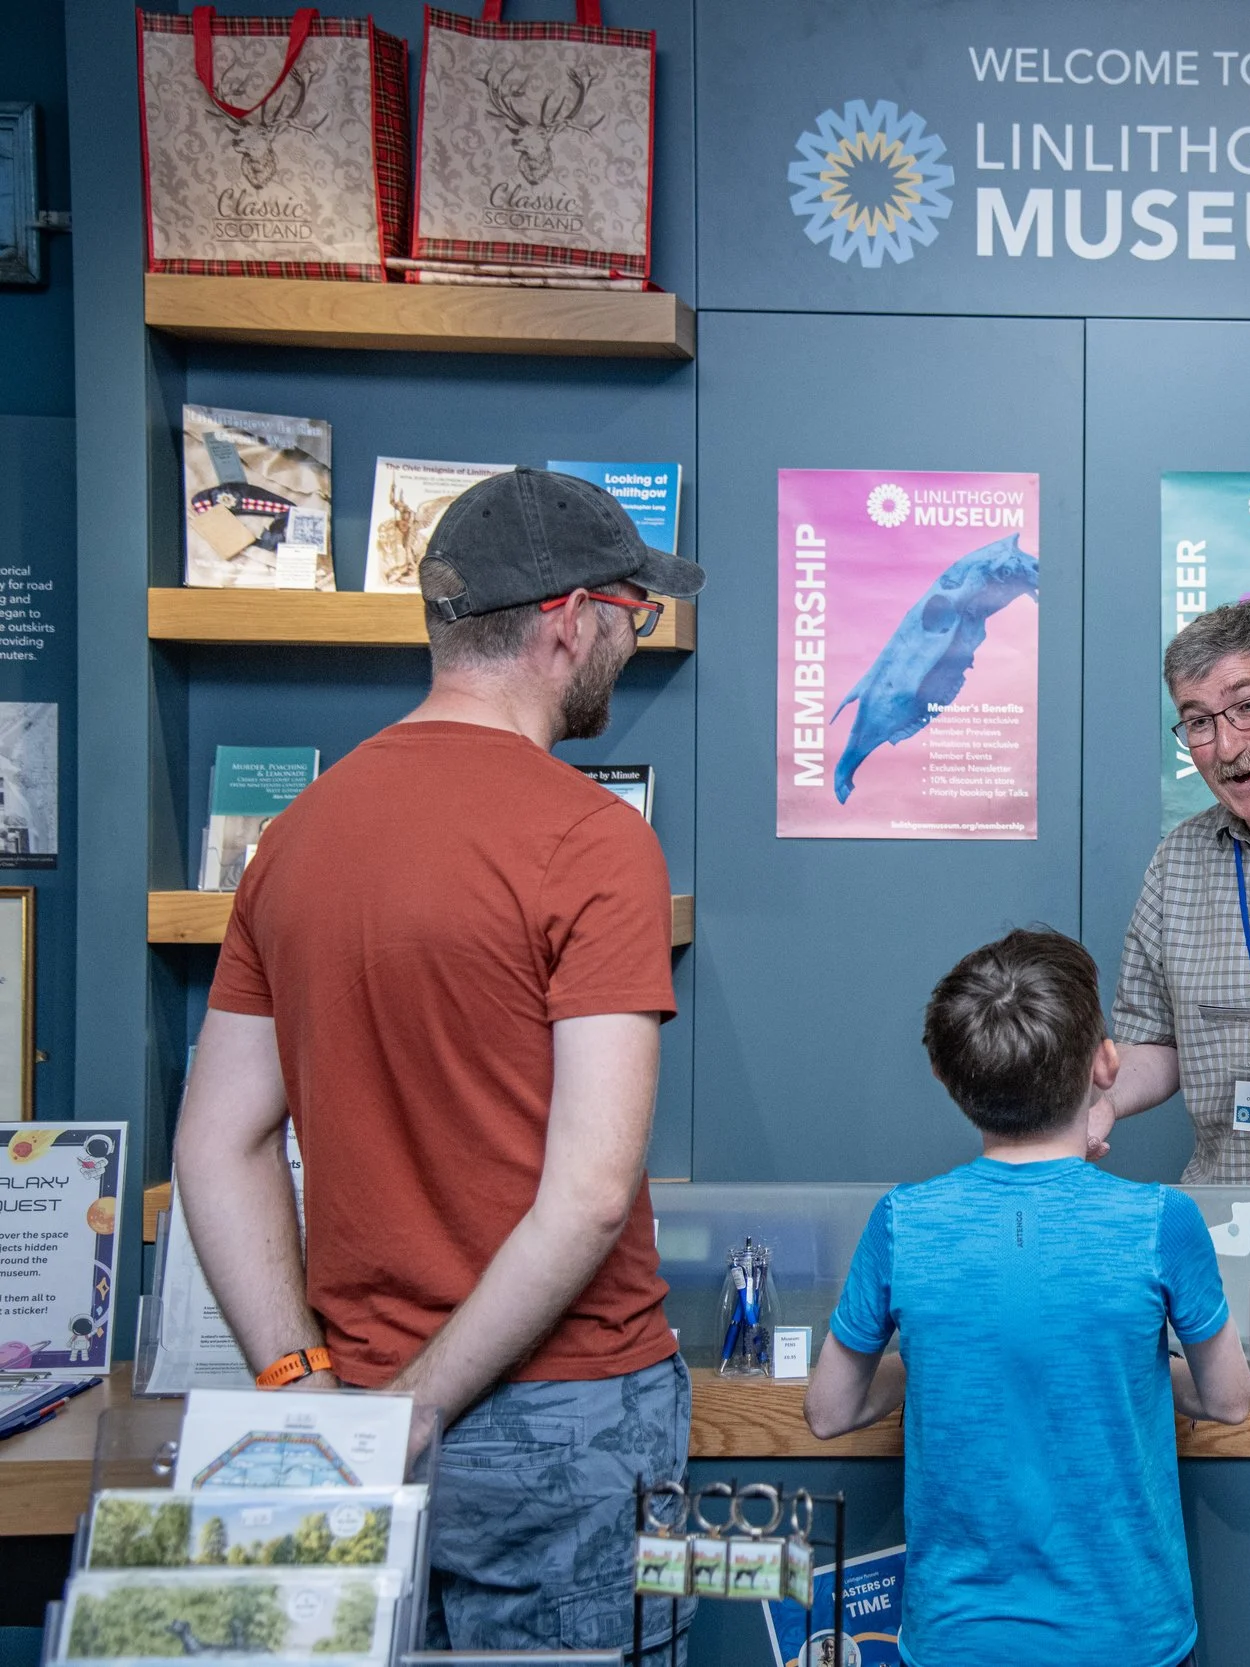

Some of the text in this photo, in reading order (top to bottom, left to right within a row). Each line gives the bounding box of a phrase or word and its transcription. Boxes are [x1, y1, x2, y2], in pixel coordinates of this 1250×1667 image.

[968, 47, 1199, 85] WELCOME
[217, 188, 304, 218] Classic
[489, 182, 577, 213] Classic
[484, 211, 584, 232] SCOTLAND
[215, 222, 313, 240] SCOTLAND
[386, 463, 465, 476] The Civic Insignia of
[605, 473, 668, 487] Looking at
[607, 487, 667, 500] Linlithgow
[914, 490, 1025, 505] LINLITHGOW
[914, 507, 1025, 528] MUSEUM
[8, 578, 24, 590] for
[27, 580, 53, 590] road
[9, 594, 31, 604] and
[29, 609, 41, 618] to
[8, 622, 55, 633] outskirts
[794, 523, 826, 787] MEMBERSHIP
[927, 703, 1025, 714] Member's Benefits
[930, 716, 970, 724] Invitations
[983, 717, 1020, 725] exclusive
[930, 728, 1001, 737] Member Previews
[929, 741, 1020, 750] Invitations to exclusive
[929, 752, 992, 761] Member Events
[929, 764, 1011, 774] Exclusive Newsletter
[599, 771, 640, 780] by Minute
[930, 776, 1015, 786] 10% discount in store
[929, 788, 1029, 799] Priority booking for Talks
[891, 821, 1025, 832] linlithgowmuseum.org/membership
[23, 1231, 69, 1242] the space
[25, 1244, 58, 1252] hidden
[32, 1256, 48, 1265] the
[5, 1294, 56, 1303] them all to
[13, 1306, 48, 1315] sticker!
[882, 1576, 896, 1588] OF
[846, 1593, 892, 1618] TIME
